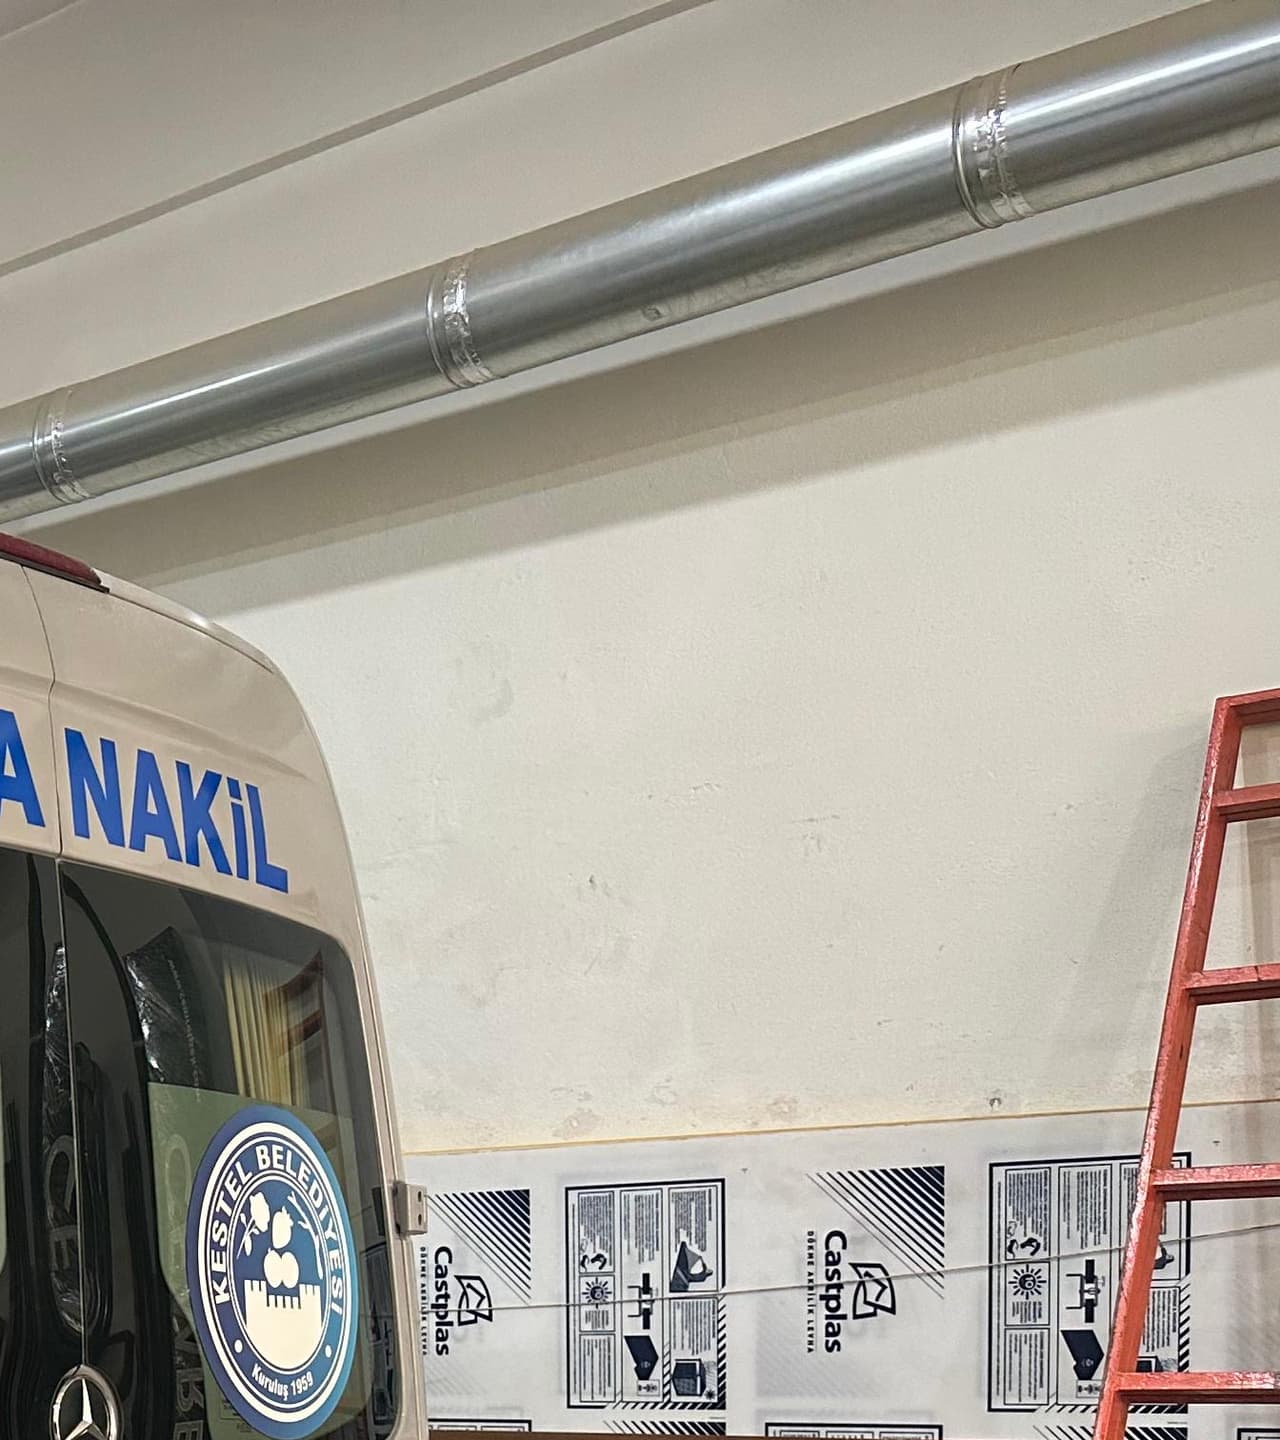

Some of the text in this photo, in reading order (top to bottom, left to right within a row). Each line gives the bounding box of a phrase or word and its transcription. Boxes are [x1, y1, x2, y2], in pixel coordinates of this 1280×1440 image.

[210, 1161, 253, 1306] KESTEL
[819, 1229, 848, 1354] Castplas
[430, 1245, 454, 1357] Castplas
[251, 1362, 314, 1402] Kuruluş 1959
